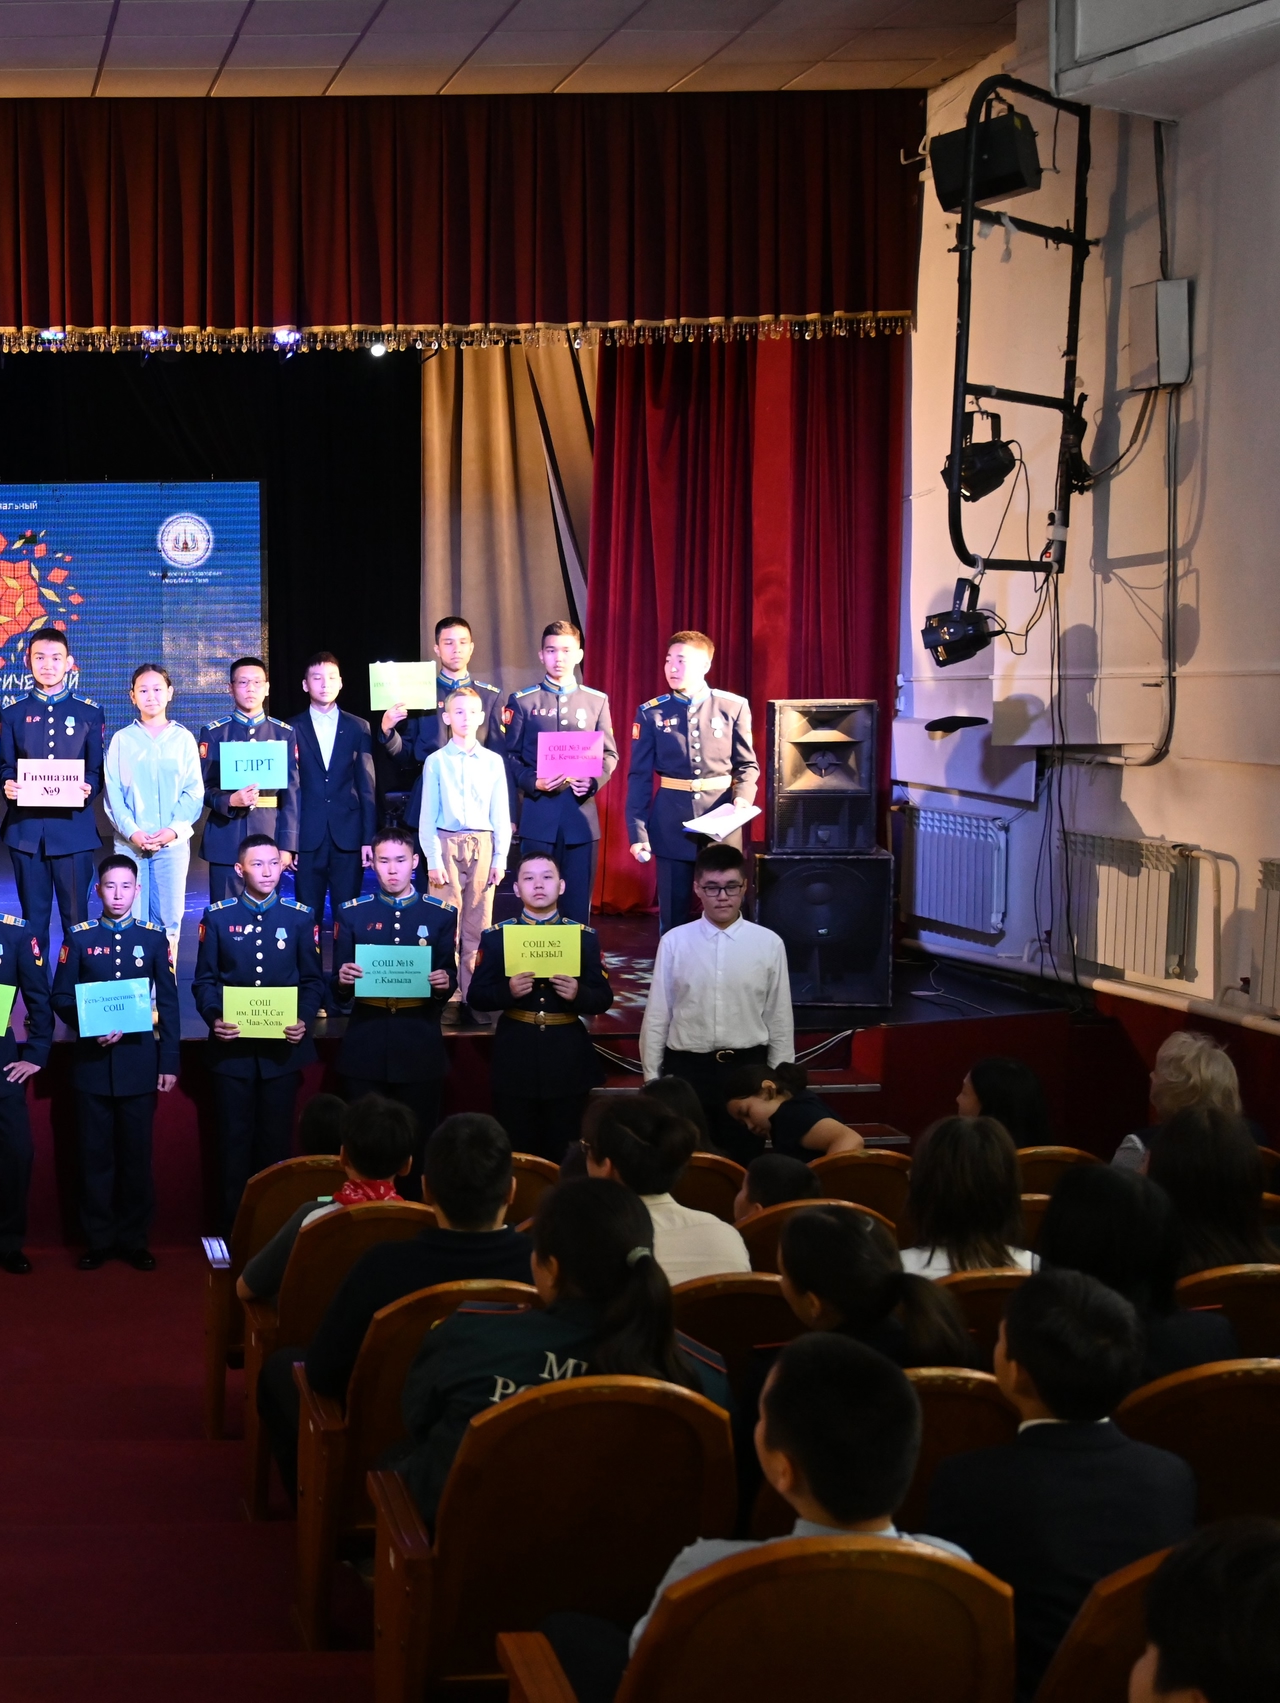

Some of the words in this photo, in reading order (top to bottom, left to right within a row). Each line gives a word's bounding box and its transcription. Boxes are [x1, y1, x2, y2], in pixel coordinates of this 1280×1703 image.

[548, 744, 567, 752] СОШ
[234, 758, 275, 773] ГЛРТ
[23, 771, 79, 782] Гимназия
[40, 786, 61, 797] №9
[522, 940, 546, 948] СОШ
[547, 940, 561, 948] №2
[529, 950, 563, 958] КЫЗЫЛ
[371, 959, 394, 968] СОШ
[395, 959, 415, 968] №18
[374, 976, 412, 985] г.Кызыла
[249, 999, 272, 1007] СОШ
[103, 1003, 125, 1013] СОШ
[251, 1009, 285, 1017] Ш.Ч.Сат
[246, 1018, 283, 1027] Чаа-Холь
